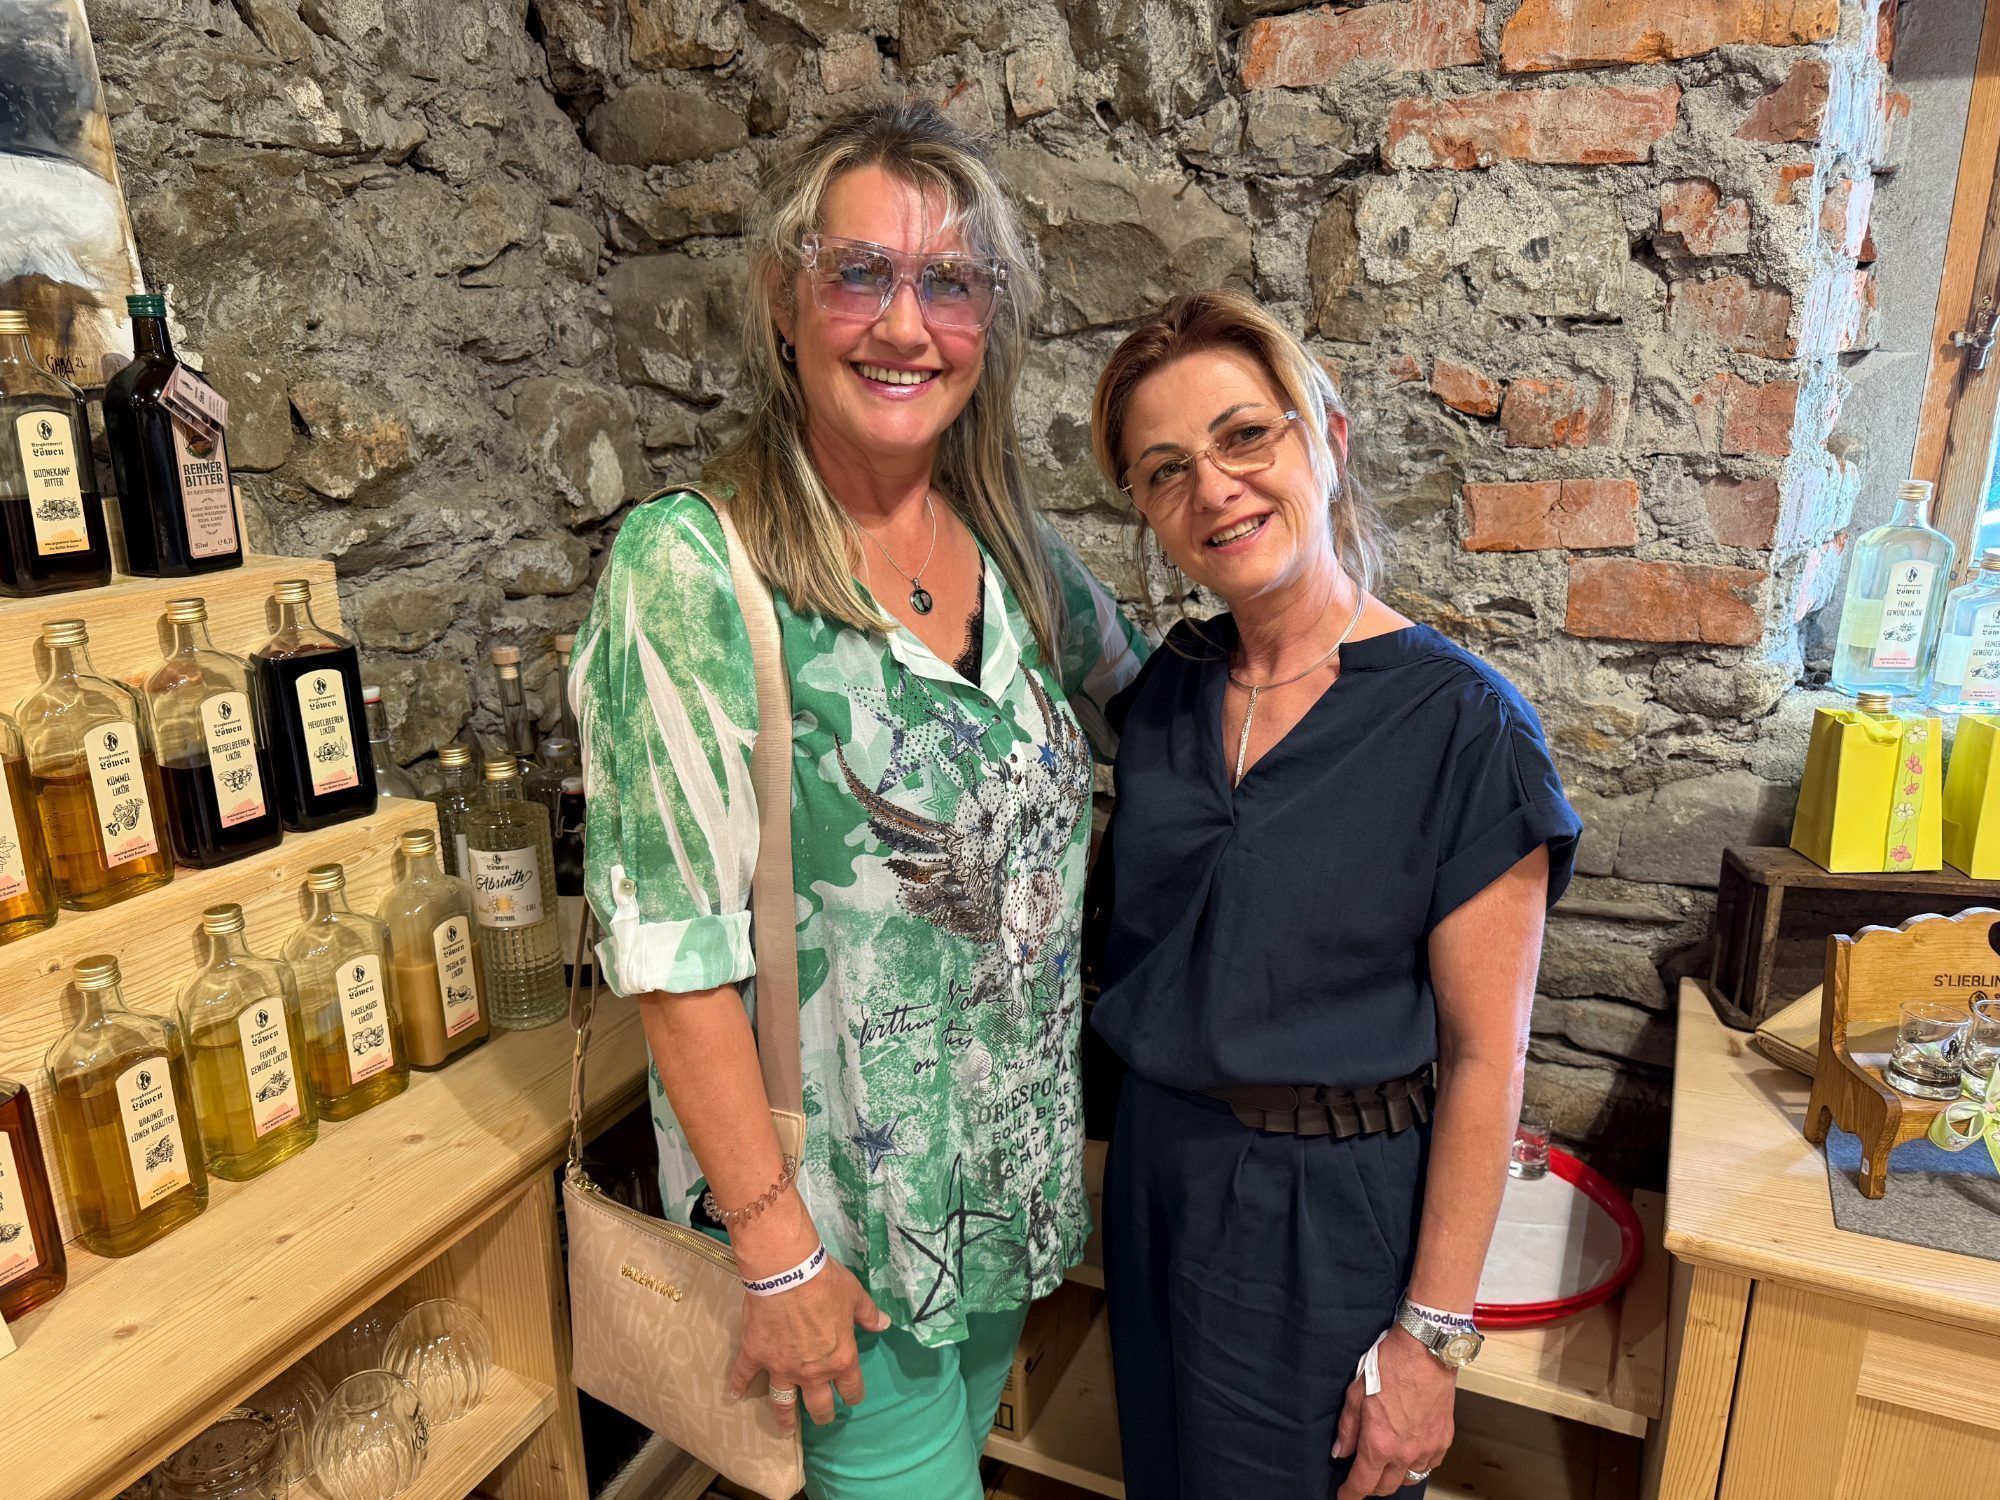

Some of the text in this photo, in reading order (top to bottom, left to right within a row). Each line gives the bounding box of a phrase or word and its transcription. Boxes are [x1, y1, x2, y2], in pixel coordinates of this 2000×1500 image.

[32, 447, 64, 457] Löwen
[33, 467, 70, 478] BOONEKAMP
[183, 461, 222, 475] REHMER
[44, 477, 64, 488] BITTER
[185, 473, 225, 487] BITTER
[309, 700, 337, 711] Löwen
[308, 715, 344, 730] HEIDELBEEREN
[214, 725, 242, 737] Löwen
[320, 726, 336, 736] LIKÖR
[212, 738, 250, 755] PREISELBEEREN
[225, 750, 241, 762] LIKÖR
[100, 757, 130, 770] Löwen
[106, 773, 131, 787] KÜMMEL
[112, 784, 130, 797] LIKÖR
[476, 869, 533, 894] Absinth
[348, 985, 375, 999] Löwen
[350, 1000, 378, 1017] HASELNUSS
[358, 1012, 373, 1024] LIKÖR
[251, 1030, 279, 1046] Löwen
[259, 1045, 277, 1060] FEINER
[250, 1050, 288, 1076] GEWÜRZ LIKÖR
[132, 1092, 163, 1111] Löwen
[138, 1108, 164, 1127] BRAUNER
[131, 1114, 175, 1143] LÖWEN KRÄUTER
[621, 1263, 683, 1303] VALENTINO
